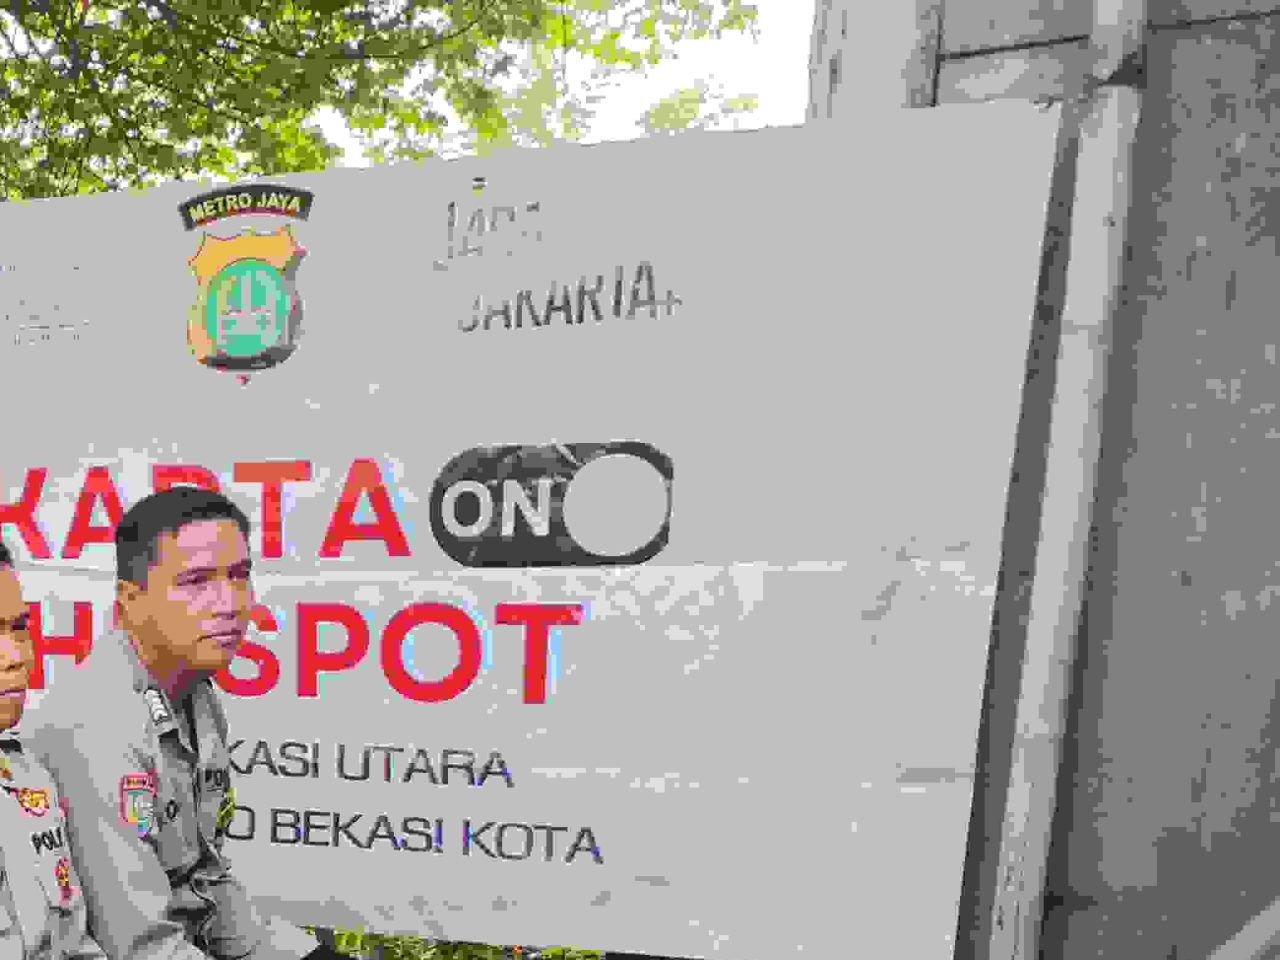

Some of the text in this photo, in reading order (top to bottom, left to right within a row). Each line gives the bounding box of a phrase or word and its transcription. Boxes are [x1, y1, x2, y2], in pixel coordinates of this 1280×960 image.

[188, 192, 300, 221] METRO JAYA
[441, 479, 553, 537] ON
[228, 738, 514, 787] KASI UTARA
[270, 807, 443, 854] BEKASI
[462, 819, 603, 864] KOTA
